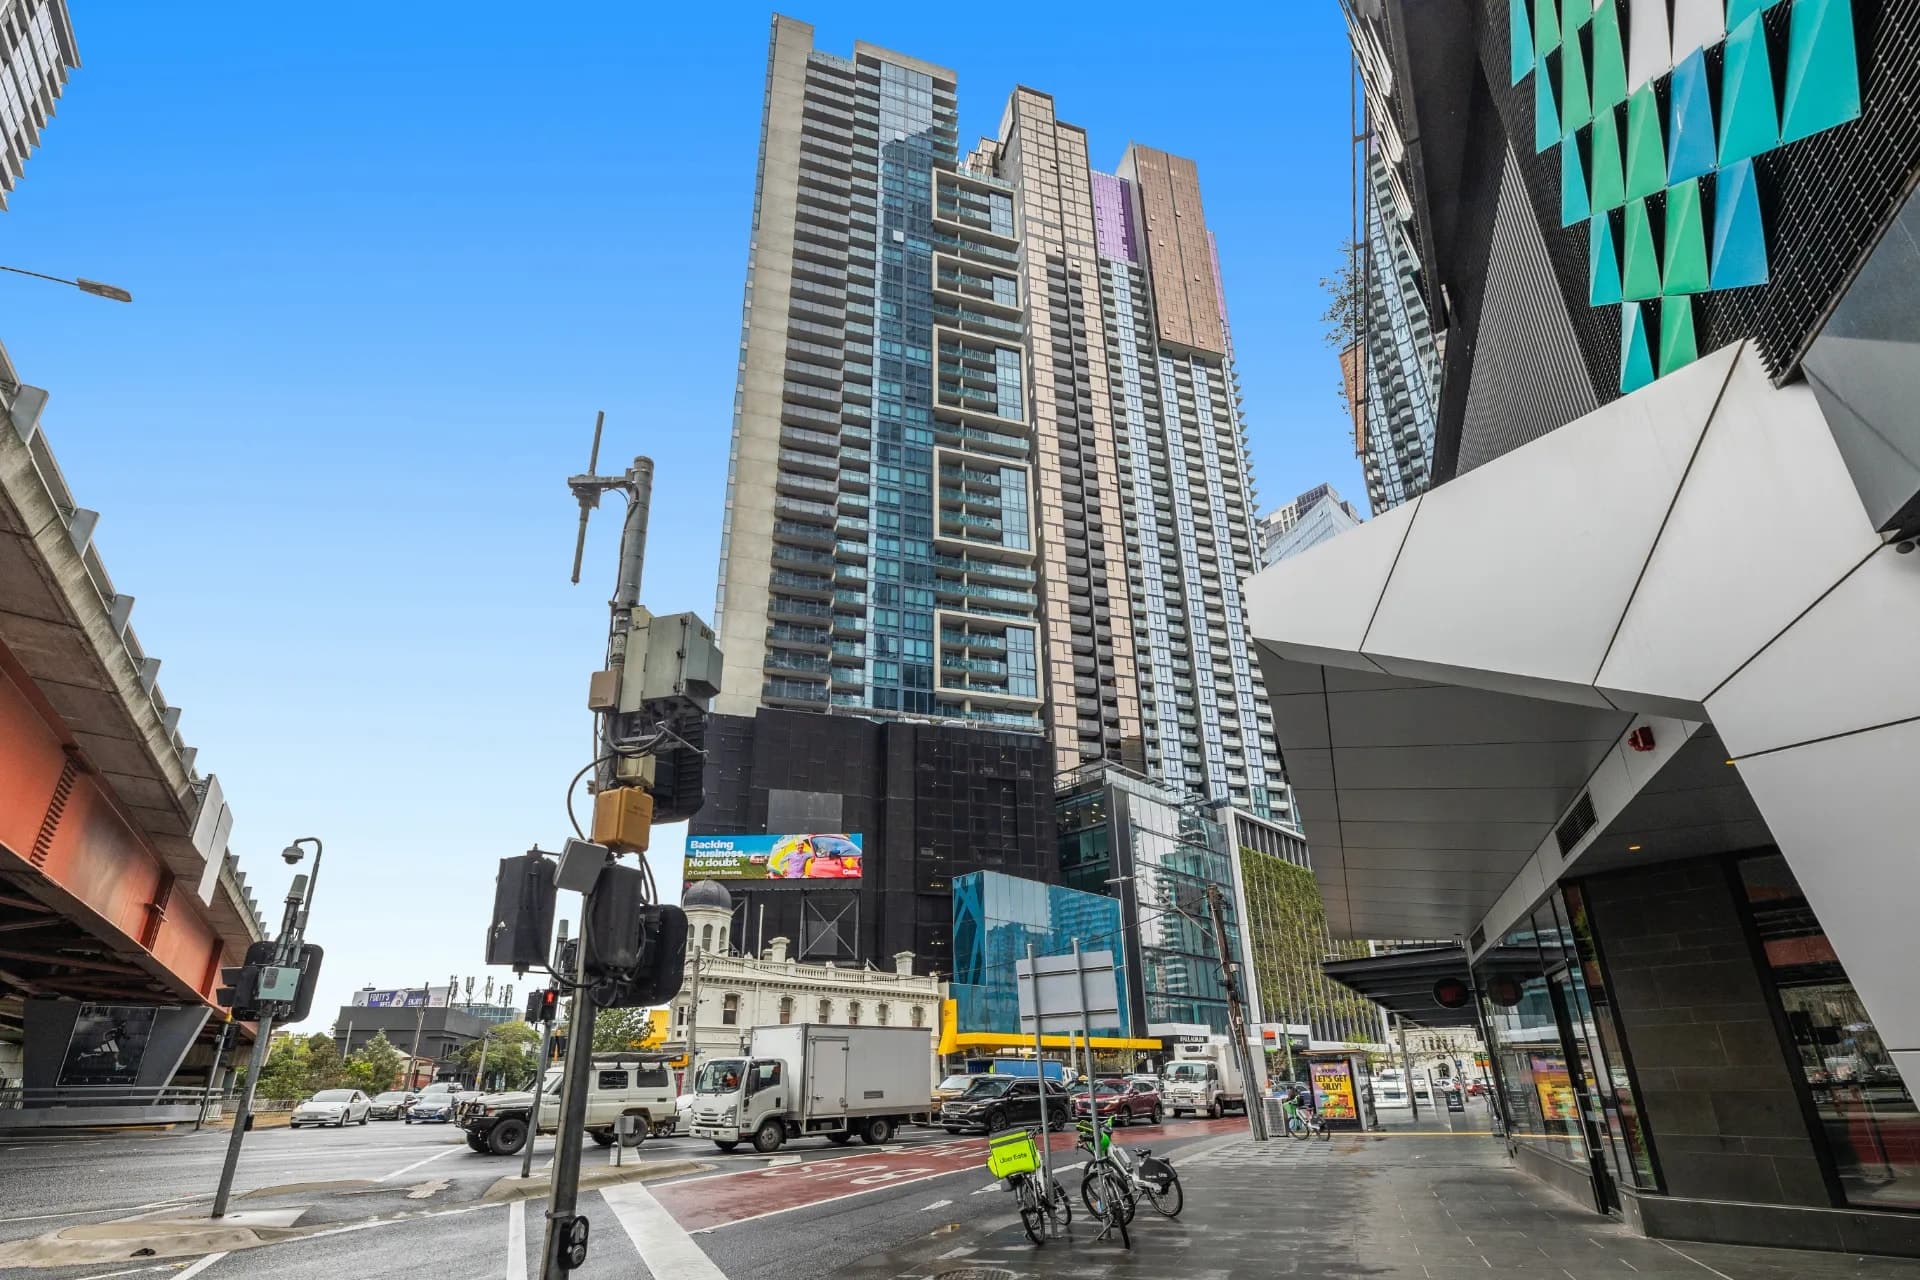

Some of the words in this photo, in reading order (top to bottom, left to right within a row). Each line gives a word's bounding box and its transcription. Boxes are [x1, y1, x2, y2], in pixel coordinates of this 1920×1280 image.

[690, 840, 734, 850] Backing
[688, 859, 704, 867] No
[705, 858, 740, 867] doubt.
[1314, 1074, 1333, 1083] LET'S
[1334, 1074, 1347, 1083] GET
